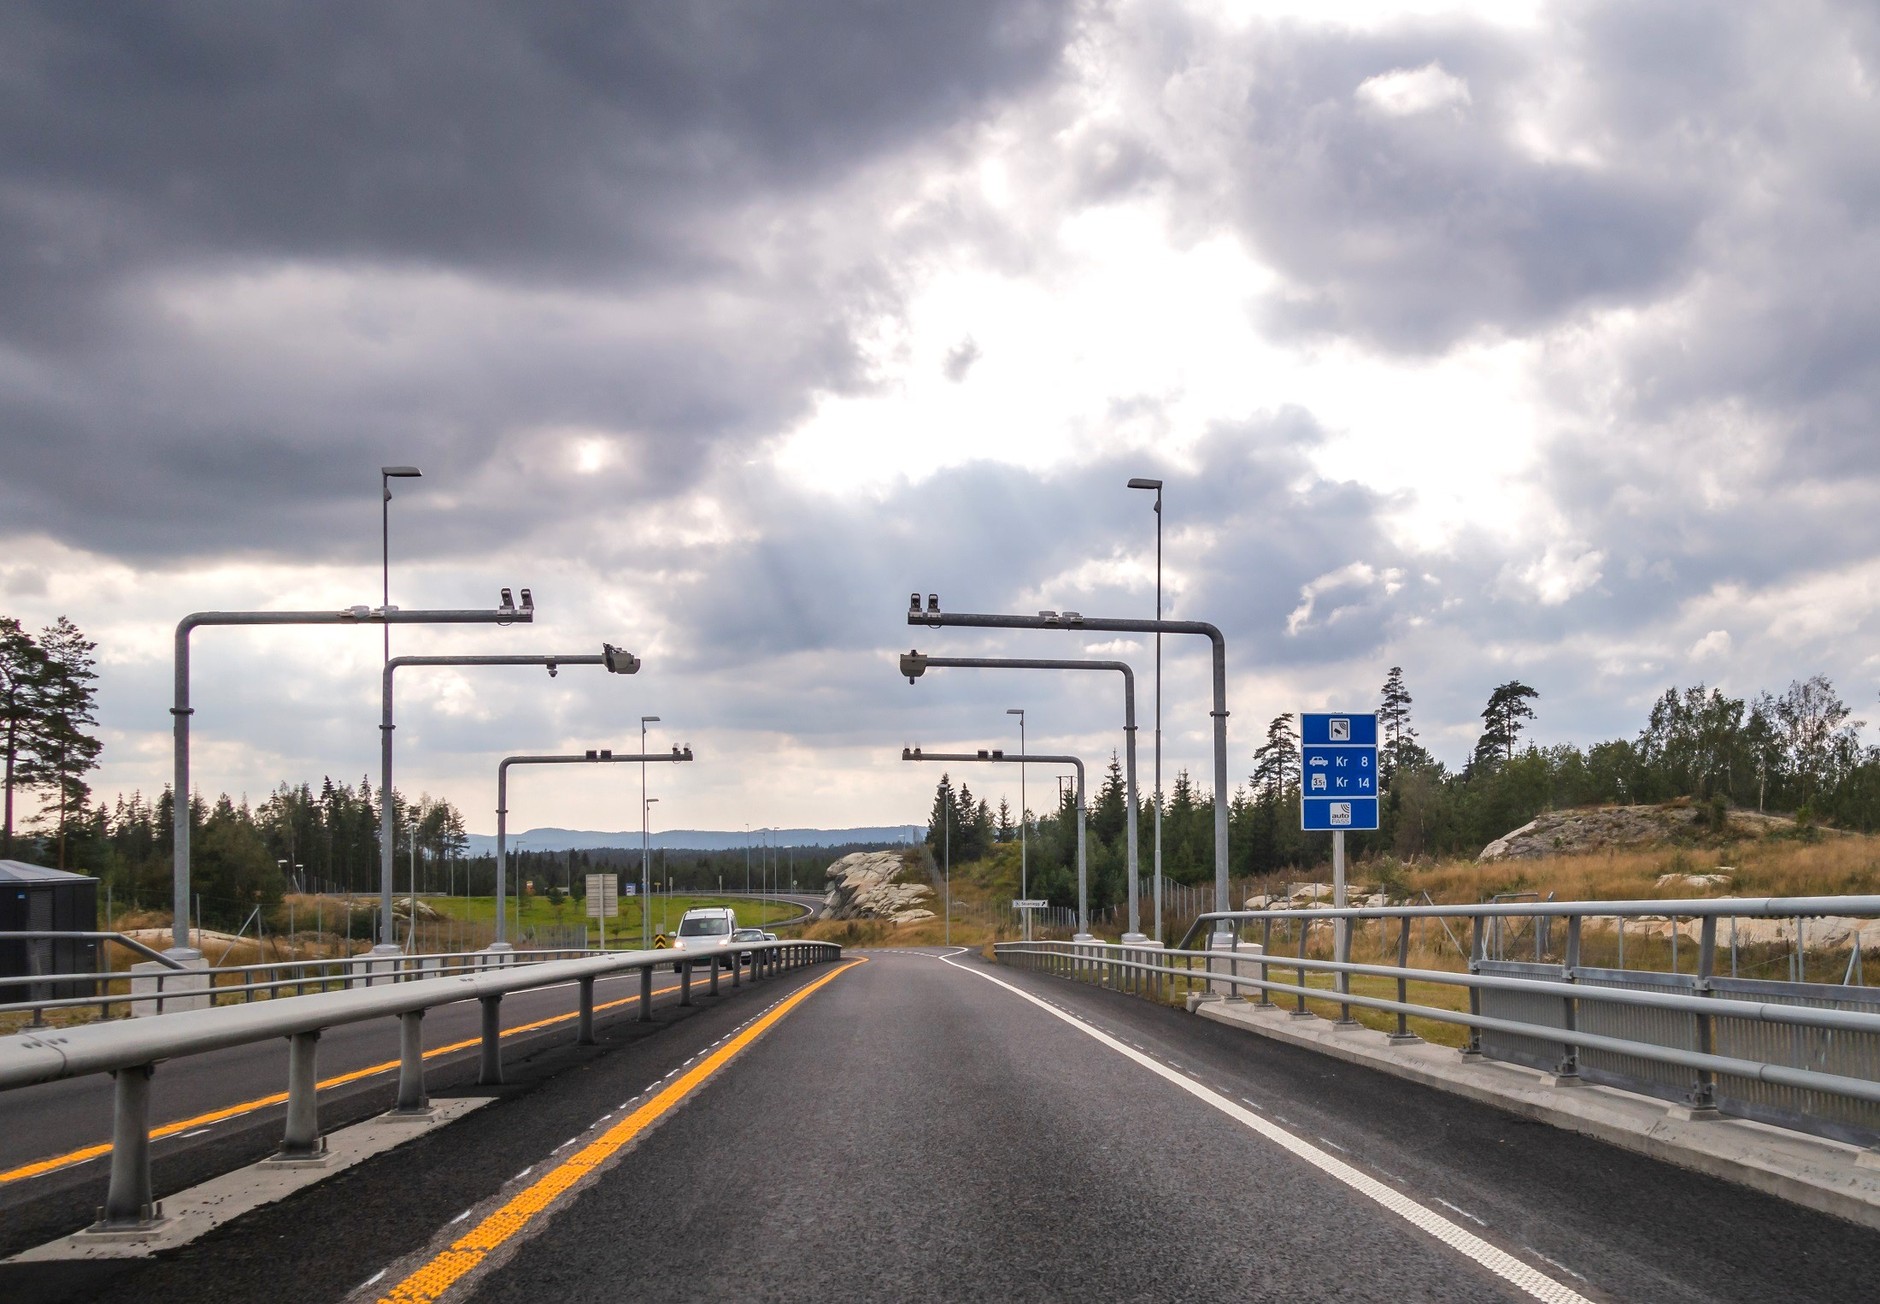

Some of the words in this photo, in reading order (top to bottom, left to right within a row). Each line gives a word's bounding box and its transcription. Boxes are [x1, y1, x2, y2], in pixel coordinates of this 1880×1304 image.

[1336, 756, 1348, 767] Kr
[1361, 756, 1368, 767] 8
[1336, 777, 1348, 787] Kr
[1358, 777, 1369, 788] 14
